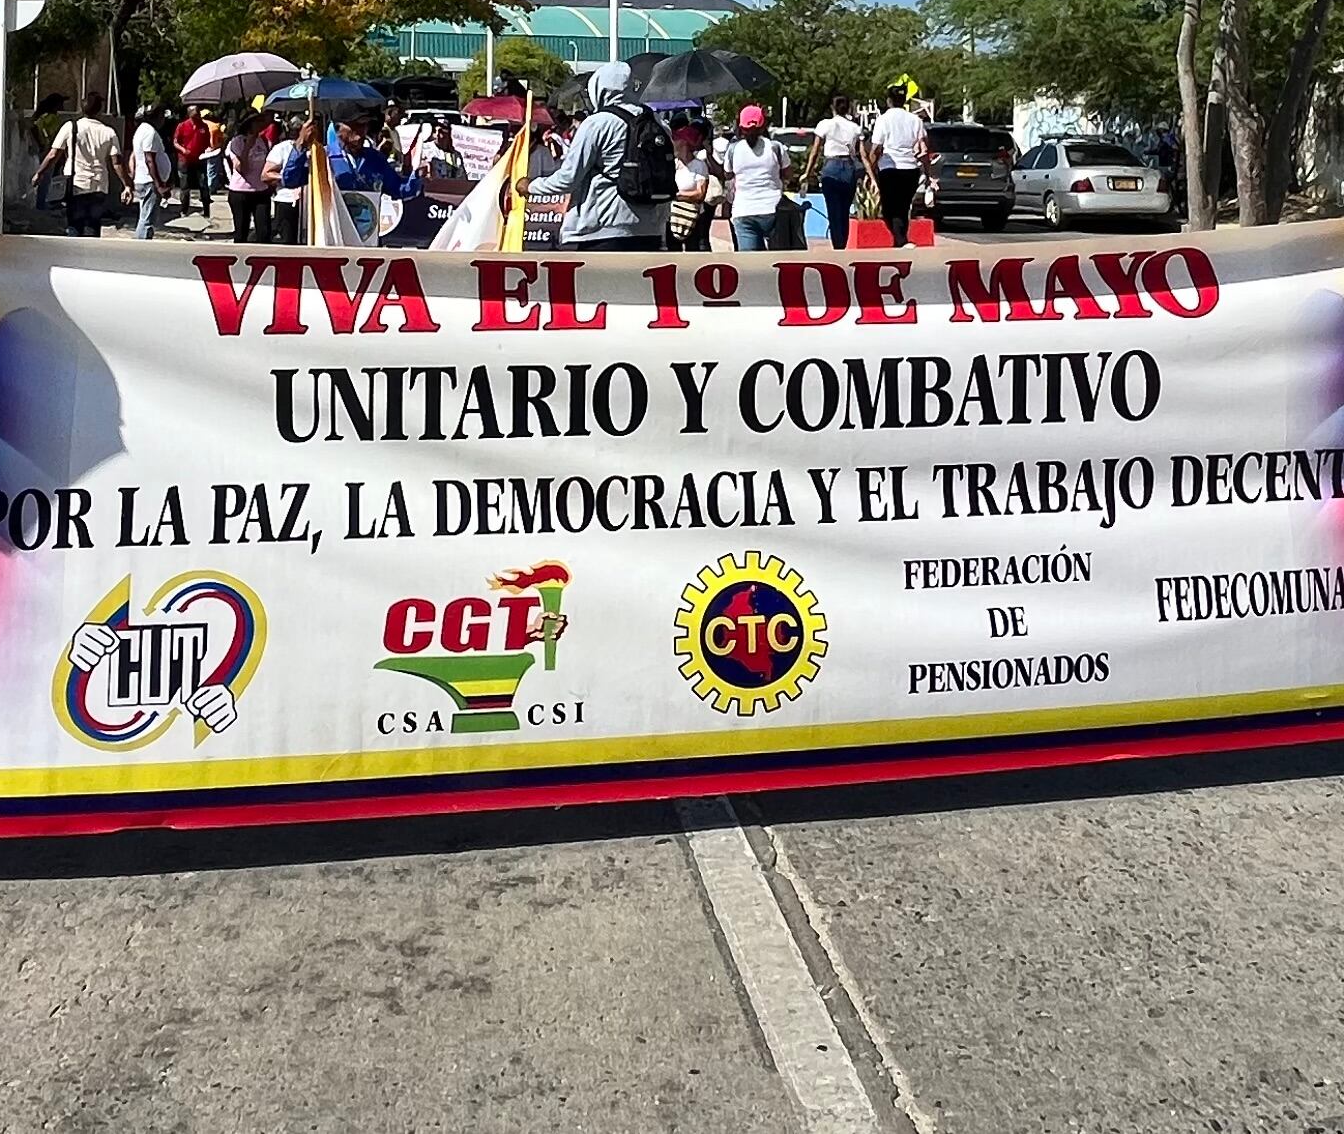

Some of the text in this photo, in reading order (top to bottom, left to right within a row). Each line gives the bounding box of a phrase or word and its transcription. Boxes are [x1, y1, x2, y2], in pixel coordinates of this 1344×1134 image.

[192, 255, 441, 336] VIVA
[470, 260, 608, 332] EL
[772, 260, 918, 327] DE
[947, 247, 1220, 323] MAYO
[270, 349, 1161, 444] UNITARIO Y COMBATIVO
[115, 485, 191, 548] LA
[208, 482, 323, 555] PAZ,
[343, 480, 416, 540] LA
[432, 470, 796, 537] DEMOCRACIA
[807, 467, 841, 525] Y
[854, 465, 919, 523] EL
[932, 456, 1154, 529] TRABAJO
[903, 544, 1092, 590] FEDERACIÓN
[382, 596, 544, 654] CGT
[704, 612, 801, 656] CTC
[986, 606, 1029, 639] DE
[107, 623, 208, 708] CUT
[908, 653, 1110, 695] PENSIONADOS
[377, 701, 585, 735] CSA CSI
